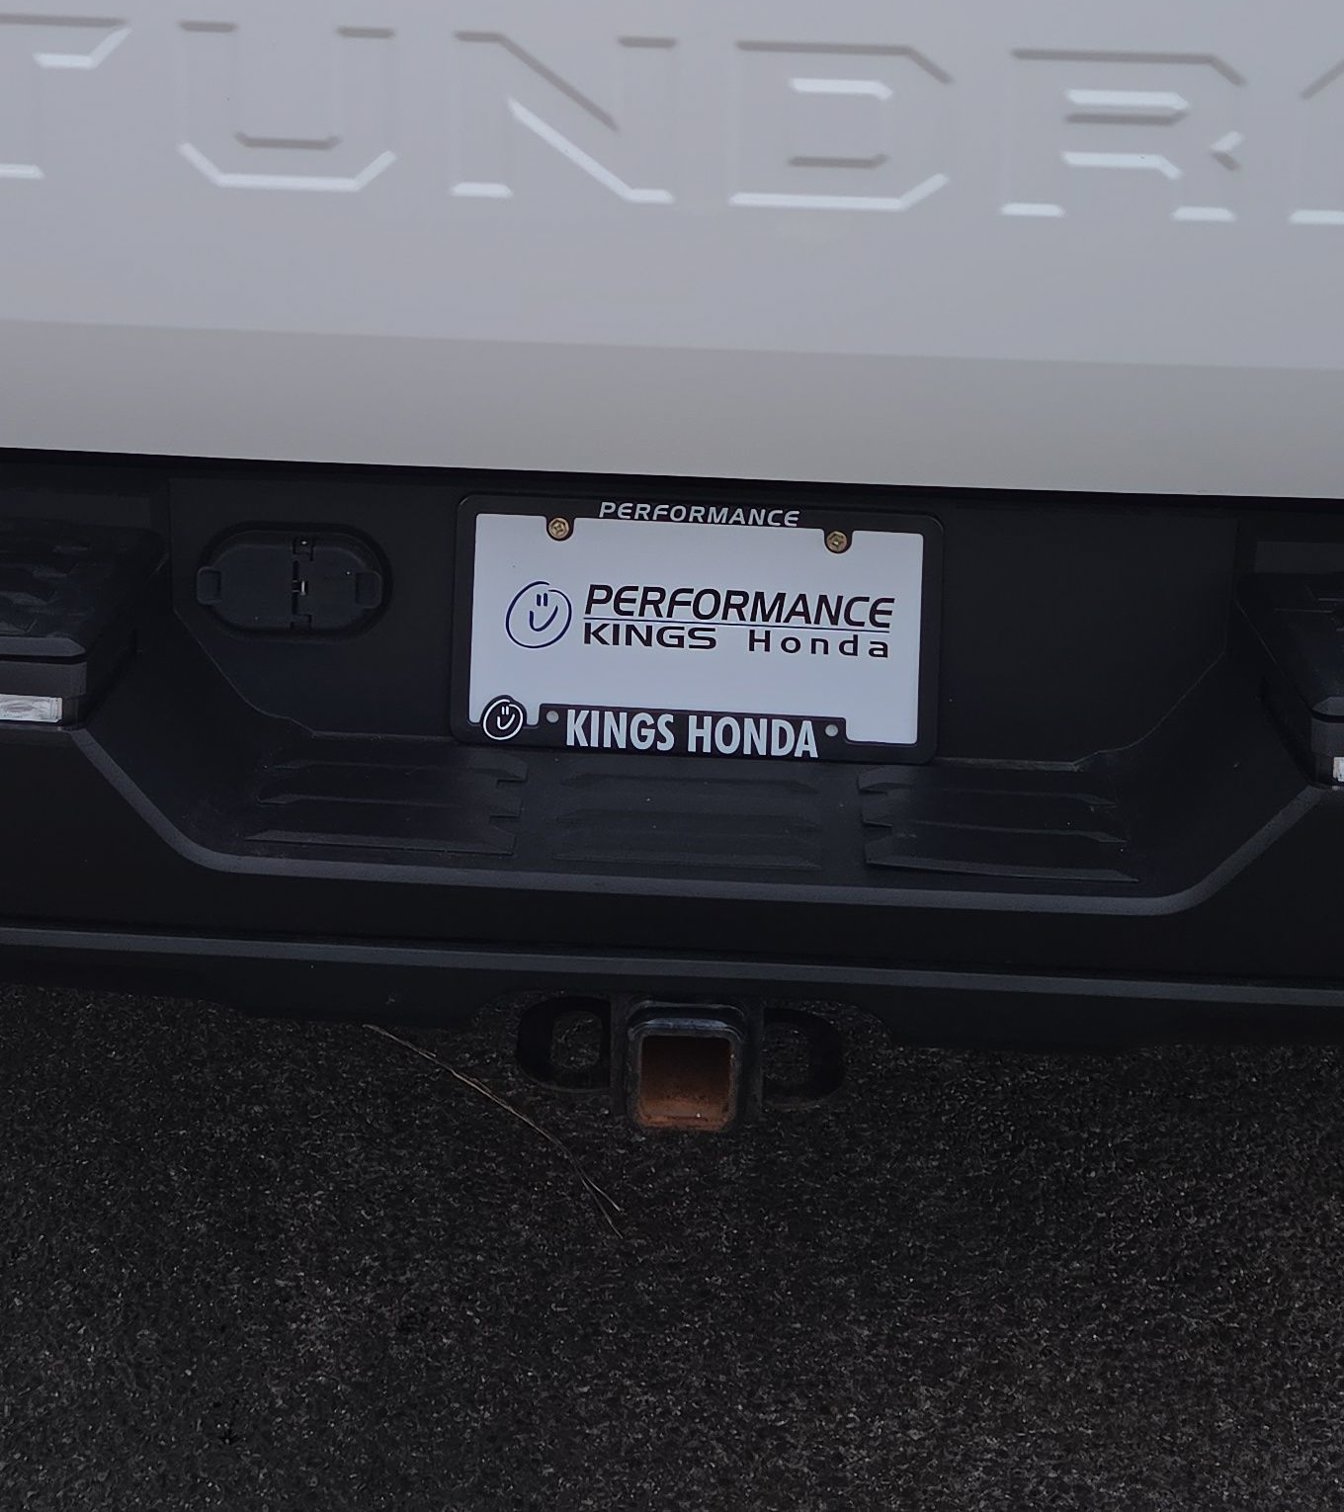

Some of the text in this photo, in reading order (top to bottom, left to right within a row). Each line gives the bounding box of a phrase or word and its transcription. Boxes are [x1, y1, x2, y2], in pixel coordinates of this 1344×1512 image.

[599, 501, 800, 527] PERFORMANCE
[584, 584, 895, 628] PERFORMANCE
[583, 622, 889, 658] KINGS Honda
[566, 709, 819, 758] KINGS HONDA
